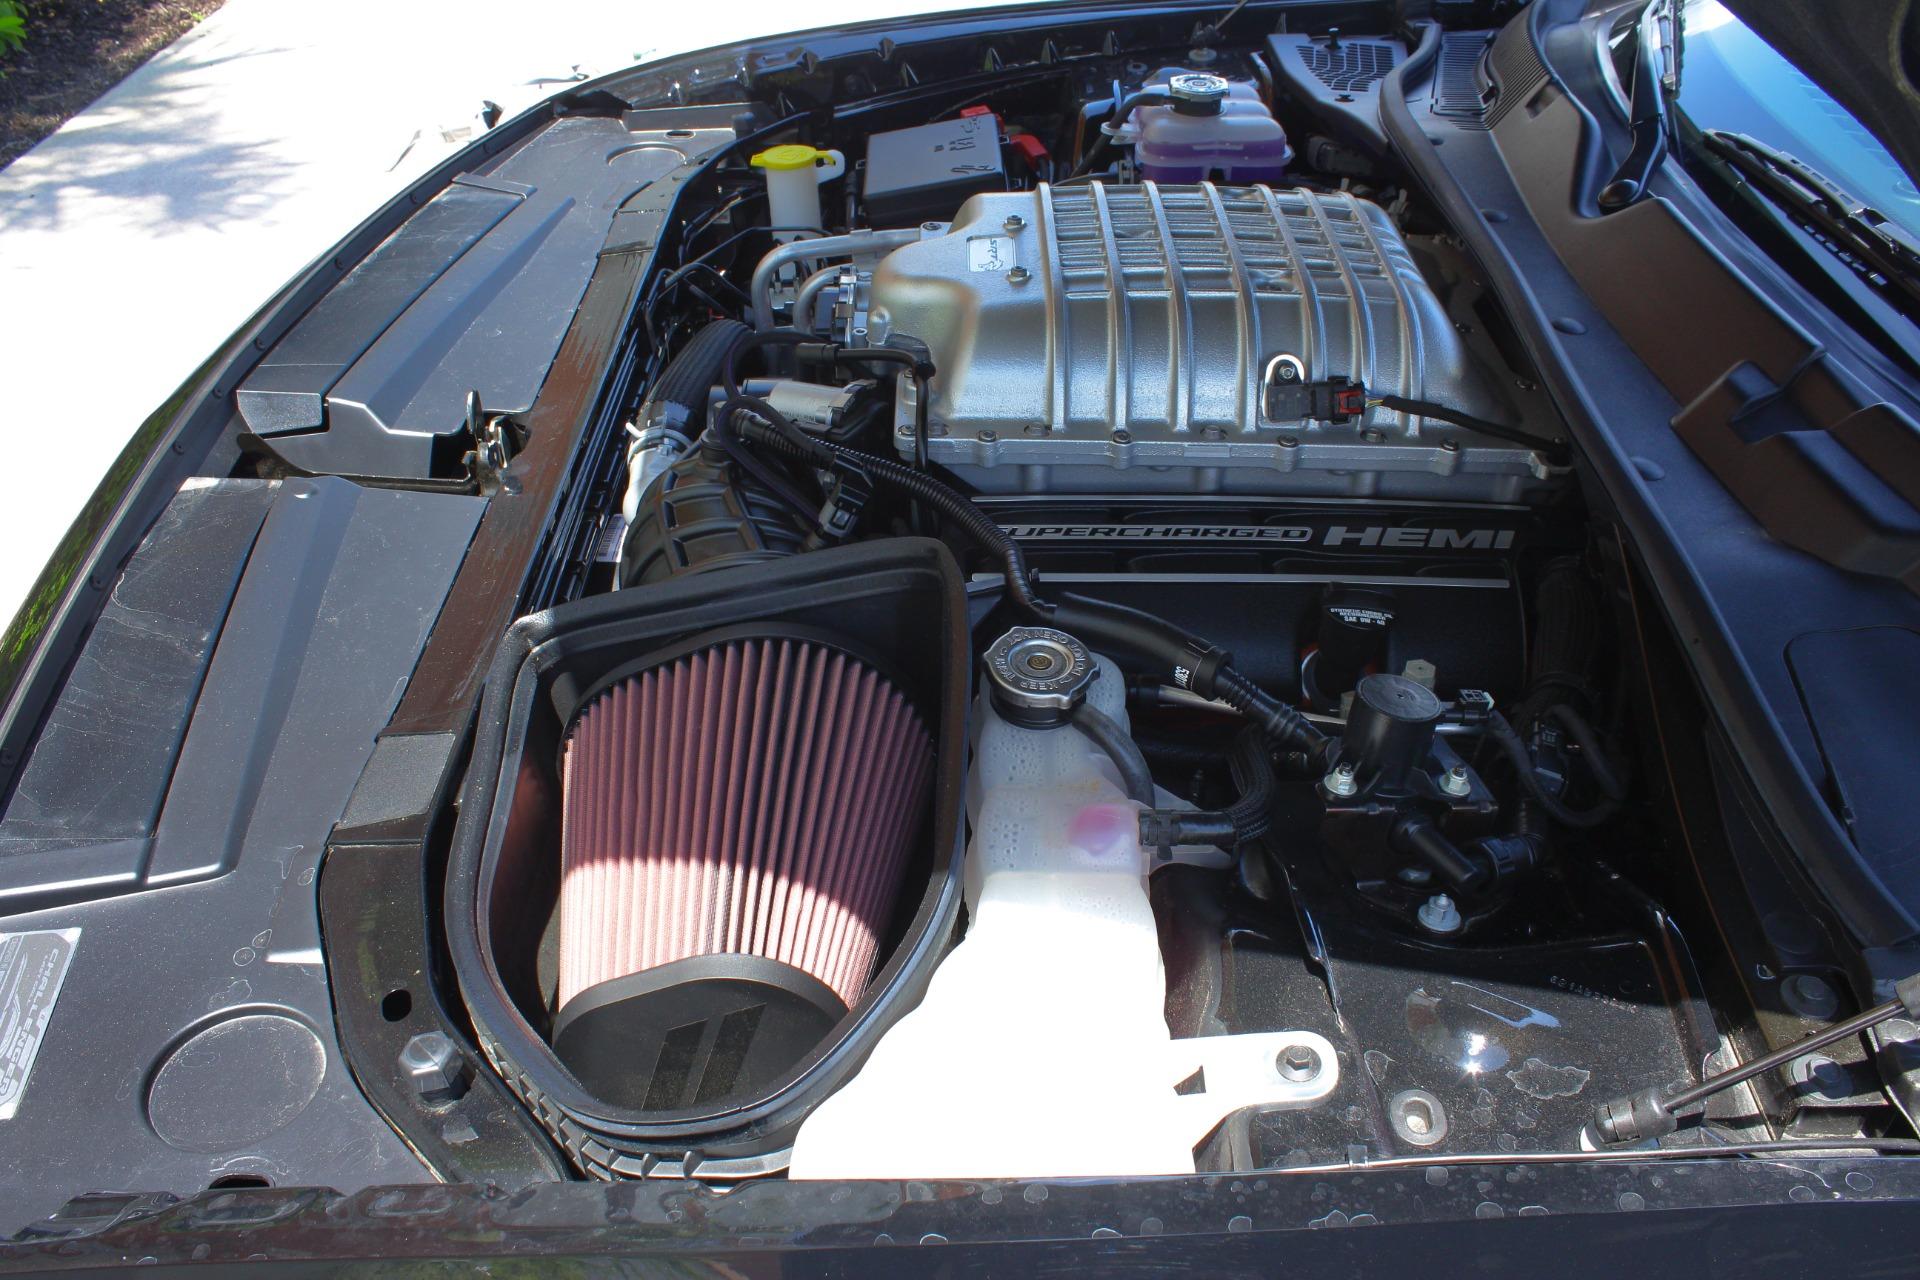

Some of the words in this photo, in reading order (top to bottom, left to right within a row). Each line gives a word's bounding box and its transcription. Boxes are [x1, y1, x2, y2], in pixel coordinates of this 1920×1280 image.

[988, 240, 998, 261] SRT
[1322, 526, 1515, 548] HEMI
[0, 948, 59, 1096] CHALLENGER
